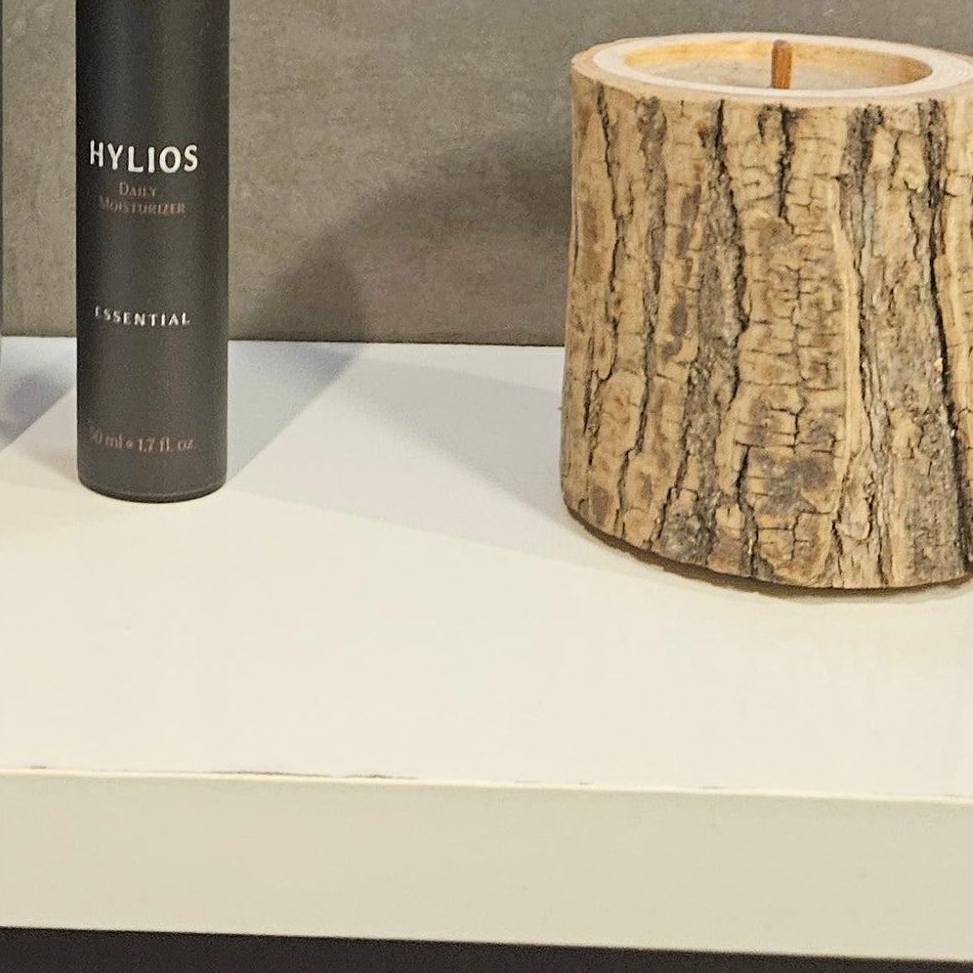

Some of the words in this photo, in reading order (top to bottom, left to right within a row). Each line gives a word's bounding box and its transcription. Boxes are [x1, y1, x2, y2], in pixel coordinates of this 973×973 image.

[89, 139, 198, 173] HYLIOS
[94, 305, 190, 327] ESSENTIAL
[106, 434, 123, 449] ml
